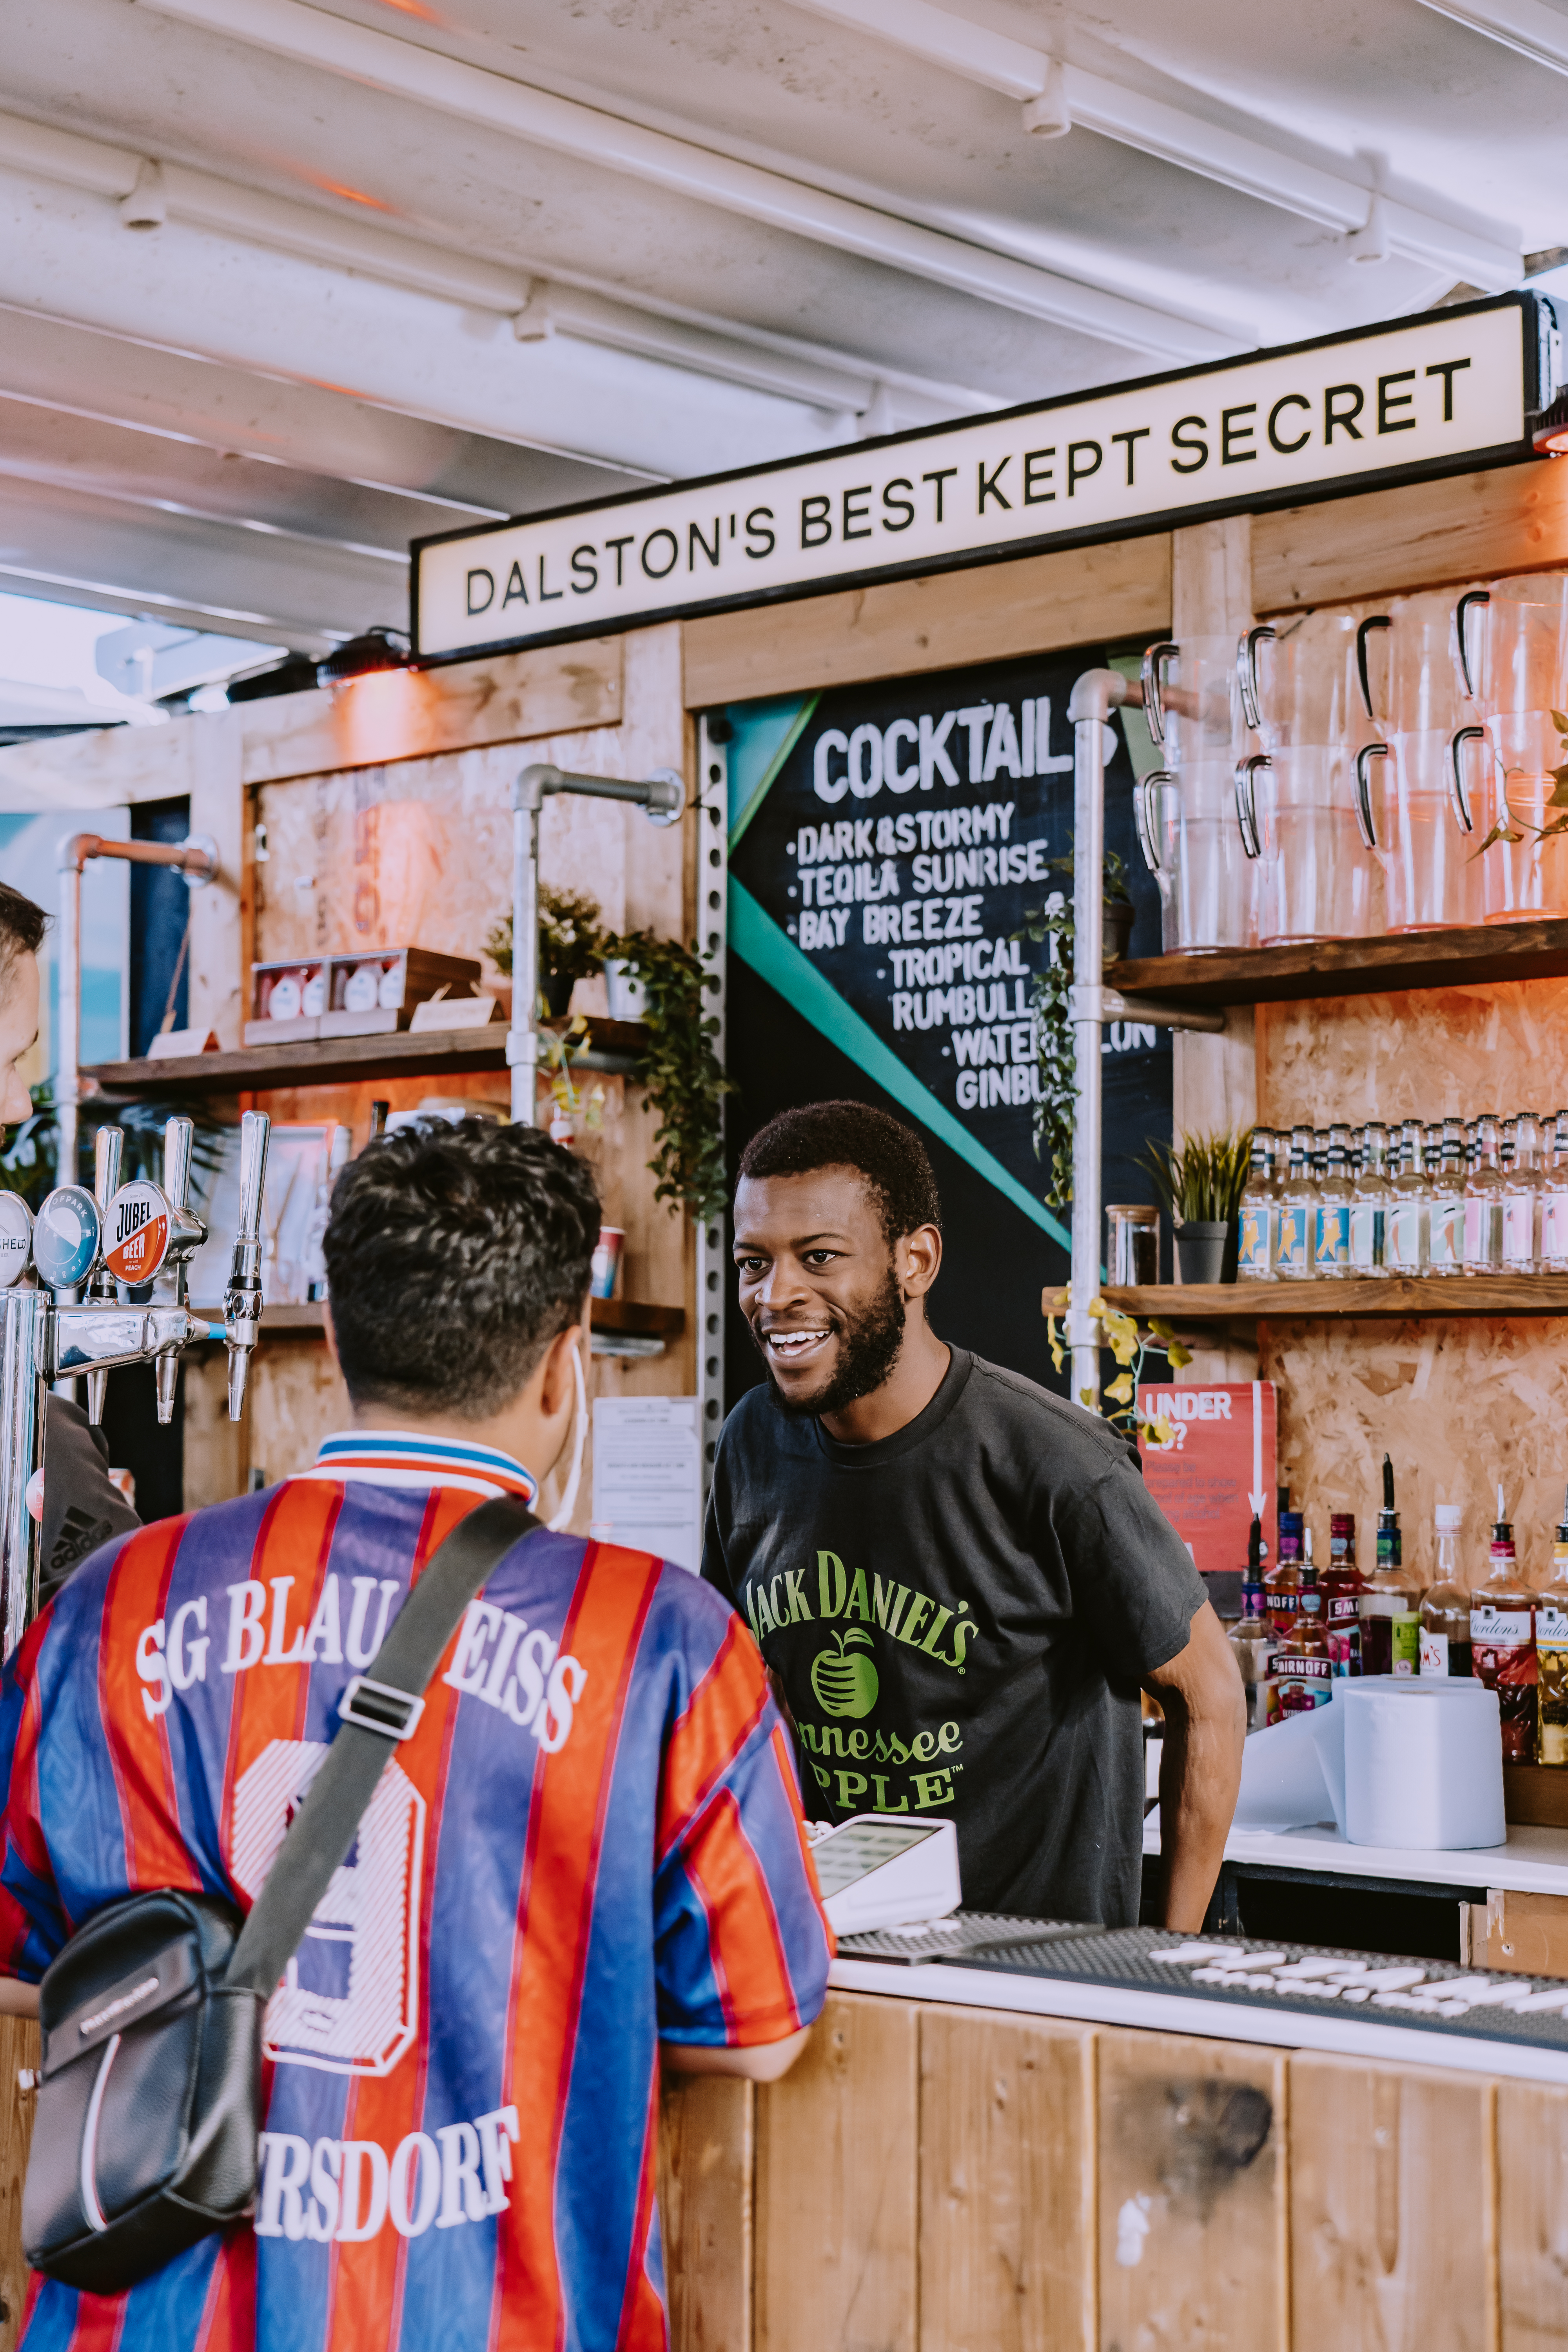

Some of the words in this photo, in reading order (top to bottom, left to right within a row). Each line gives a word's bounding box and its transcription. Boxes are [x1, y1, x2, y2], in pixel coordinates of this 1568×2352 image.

[466, 506, 776, 617] DALSTON'S
[800, 467, 958, 550] BEST
[978, 427, 1150, 515] KEPT
[1170, 357, 1472, 475] SECRET
[912, 838, 1049, 894] SUNRISE
[799, 907, 851, 950] BAY
[862, 893, 984, 945] BREEZE
[887, 936, 1031, 989] TROPICAL
[52, 1196, 88, 1218] OFPARK
[116, 1201, 151, 1242] JUBEL
[123, 1233, 145, 1259] BEER
[1145, 1391, 1232, 1421] UNDER
[746, 1568, 815, 1643] JACK
[136, 1595, 211, 1722] SG
[220, 1572, 400, 1674] BLAU
[442, 1598, 588, 1755] EISS
[794, 1720, 963, 1764] nnessee
